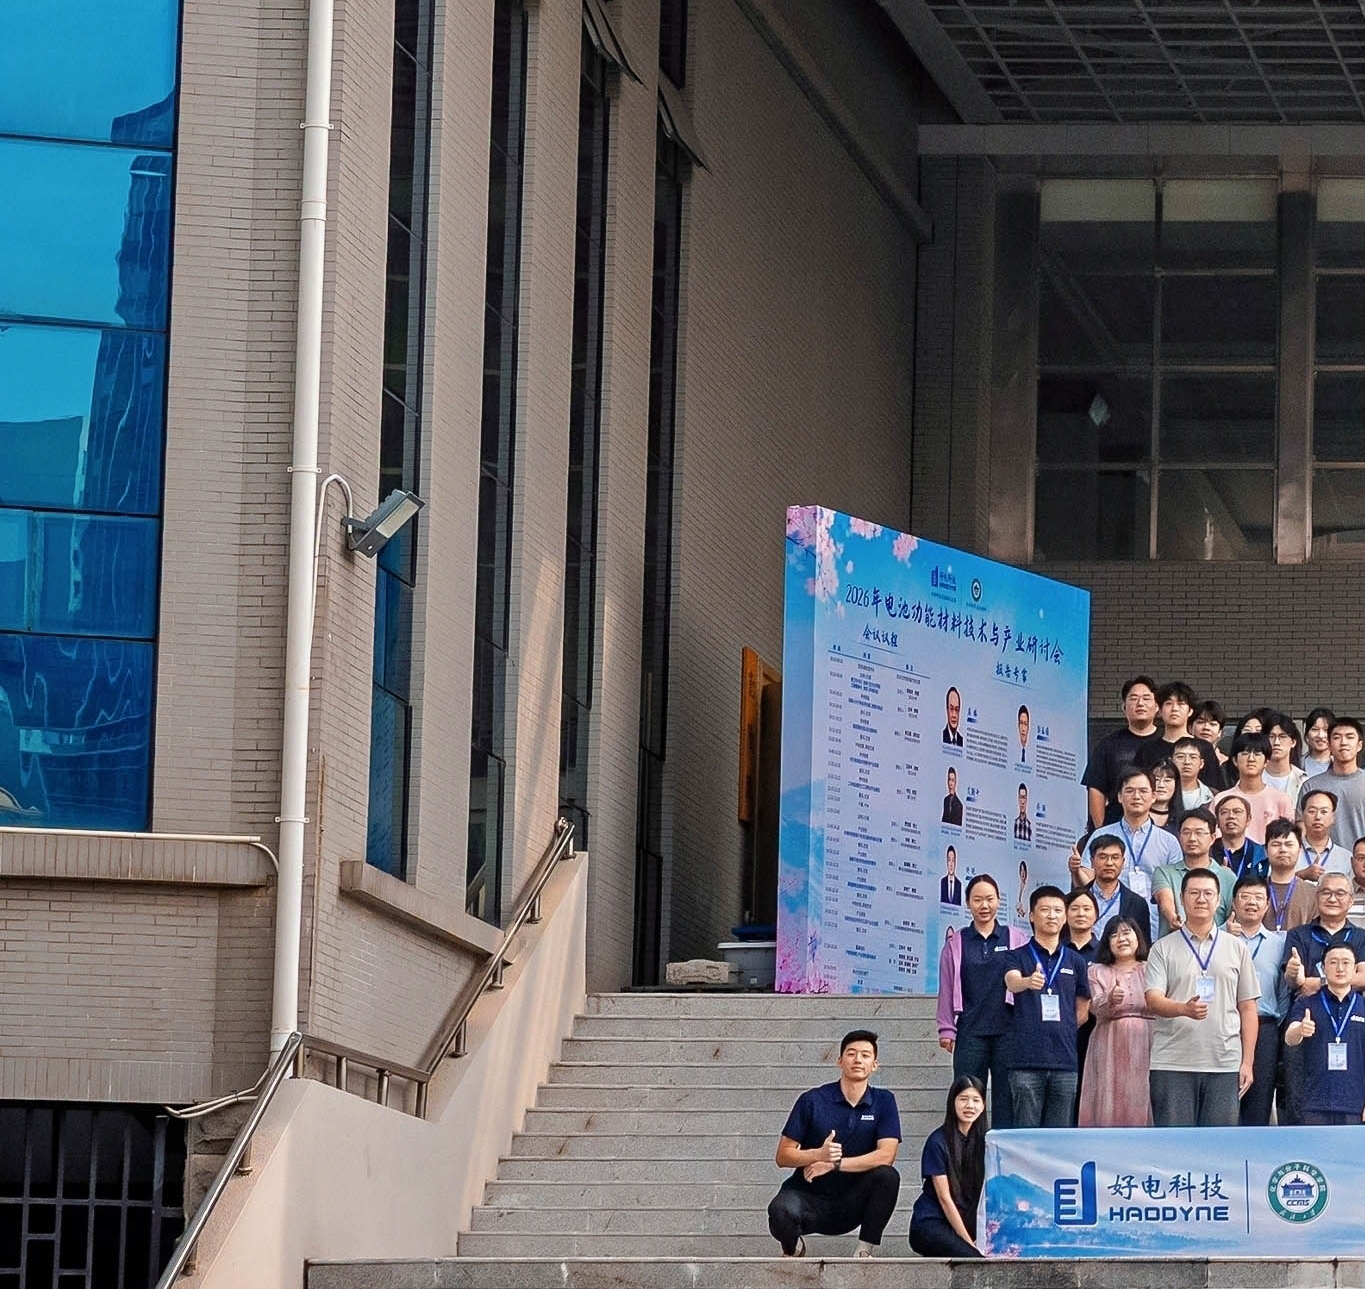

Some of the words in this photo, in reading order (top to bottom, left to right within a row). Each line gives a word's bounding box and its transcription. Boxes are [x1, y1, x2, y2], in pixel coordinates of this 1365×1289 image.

[846, 584, 1064, 666] 2026年电池功能材料技术与产业研讨会
[1107, 1171, 1230, 1203] 好电科技
[1109, 1206, 1229, 1222] HAODYNE
